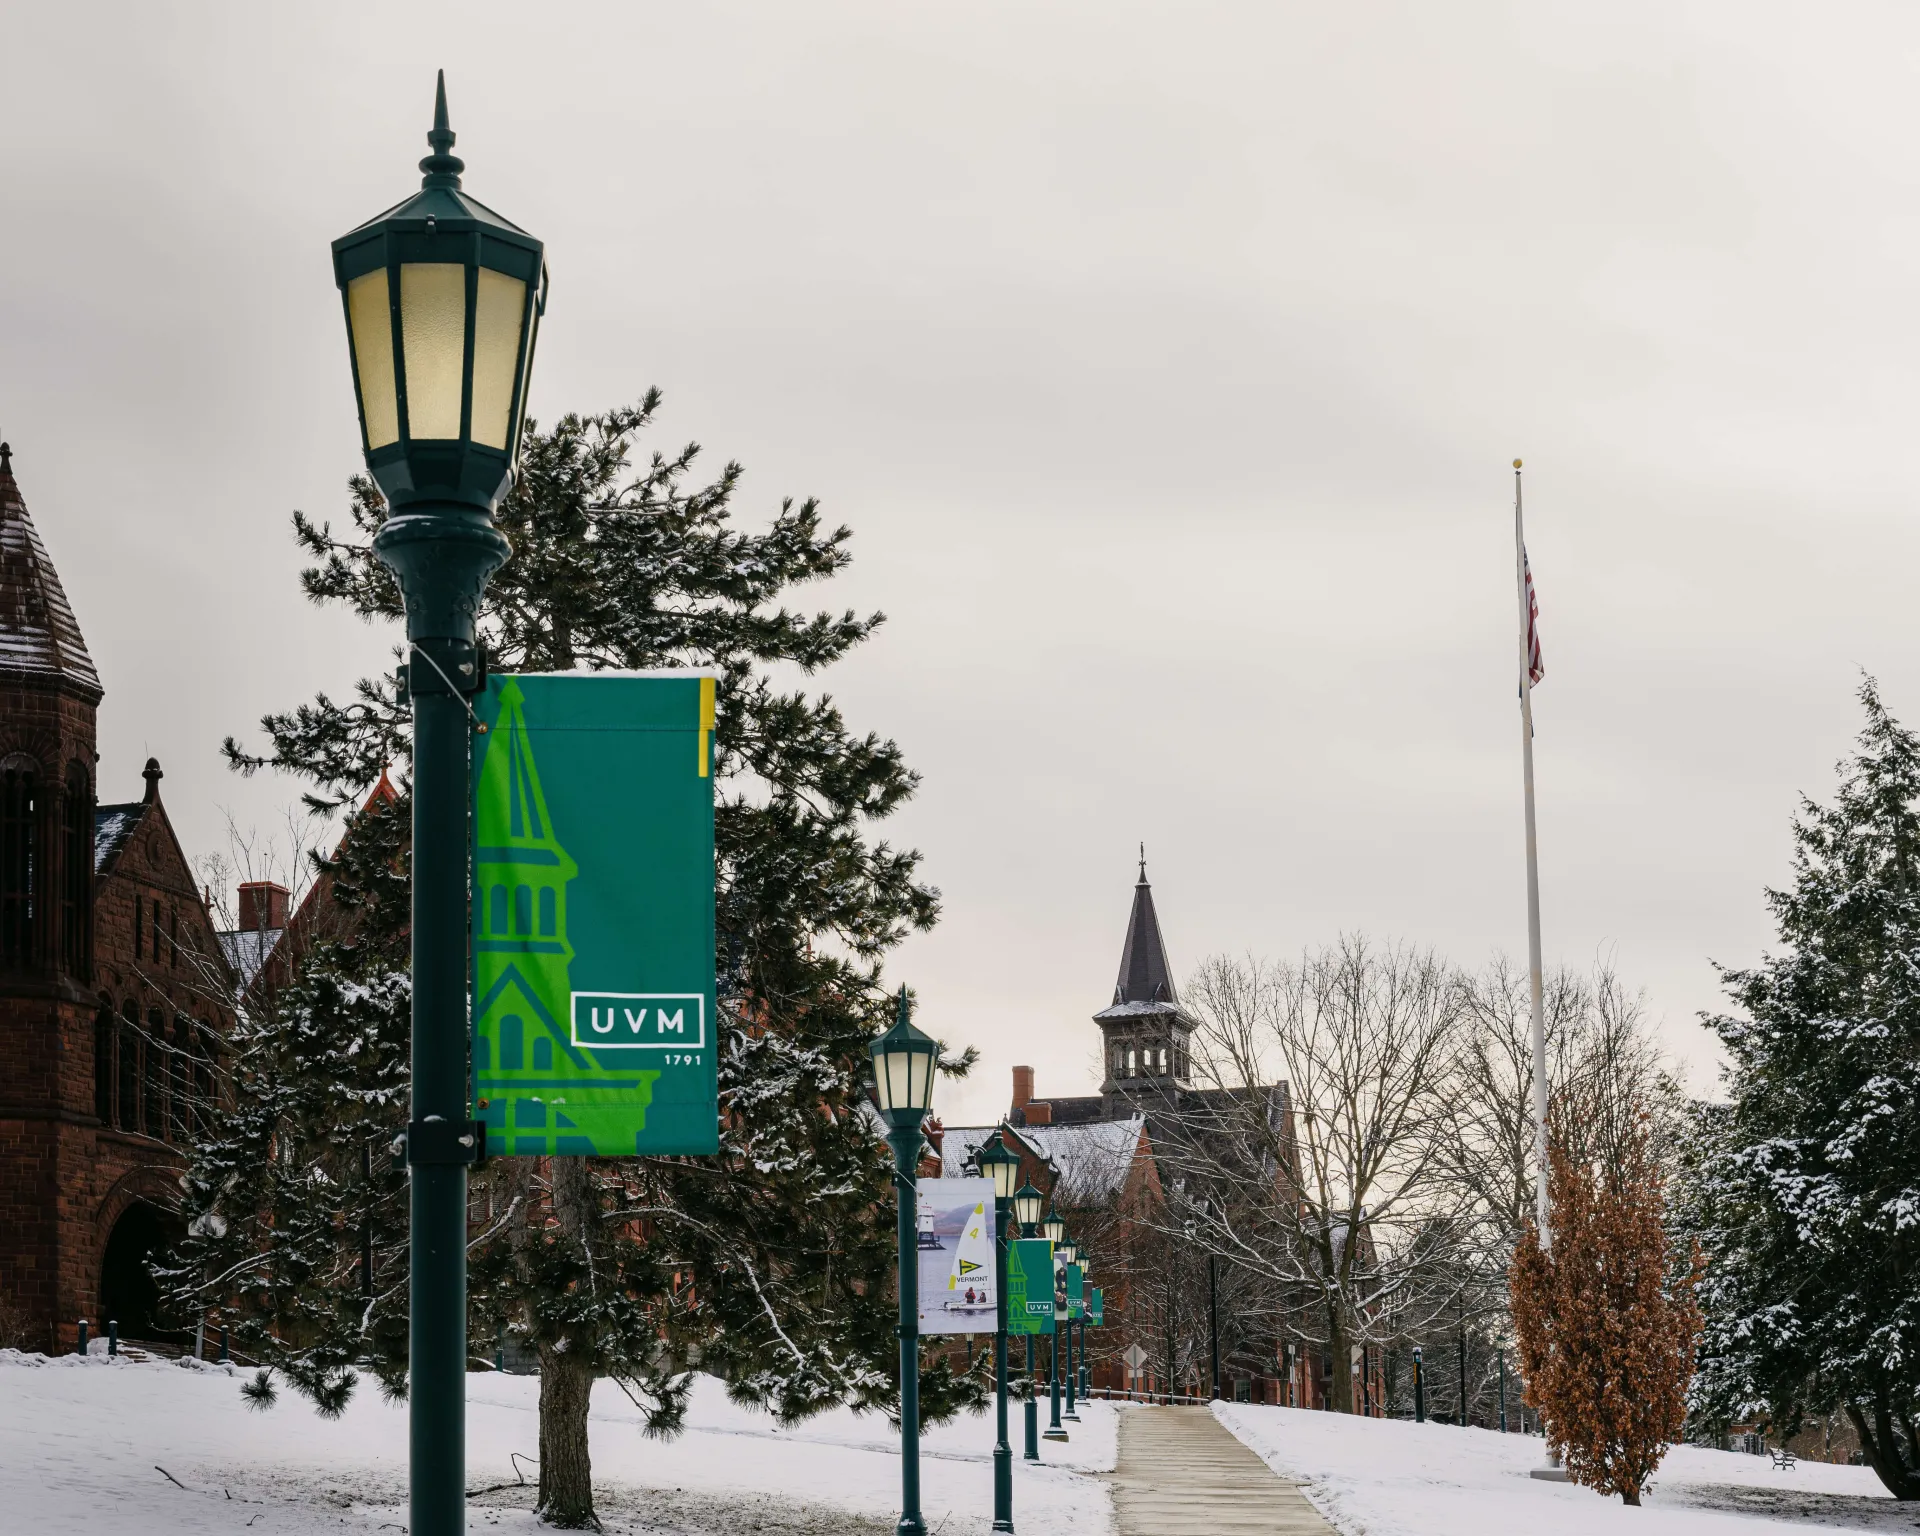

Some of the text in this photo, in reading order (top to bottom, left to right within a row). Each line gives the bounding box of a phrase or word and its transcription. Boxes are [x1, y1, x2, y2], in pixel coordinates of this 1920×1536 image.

[591, 1007, 684, 1034] UVM
[664, 1054, 701, 1066] 1791
[970, 1227, 979, 1239] 4
